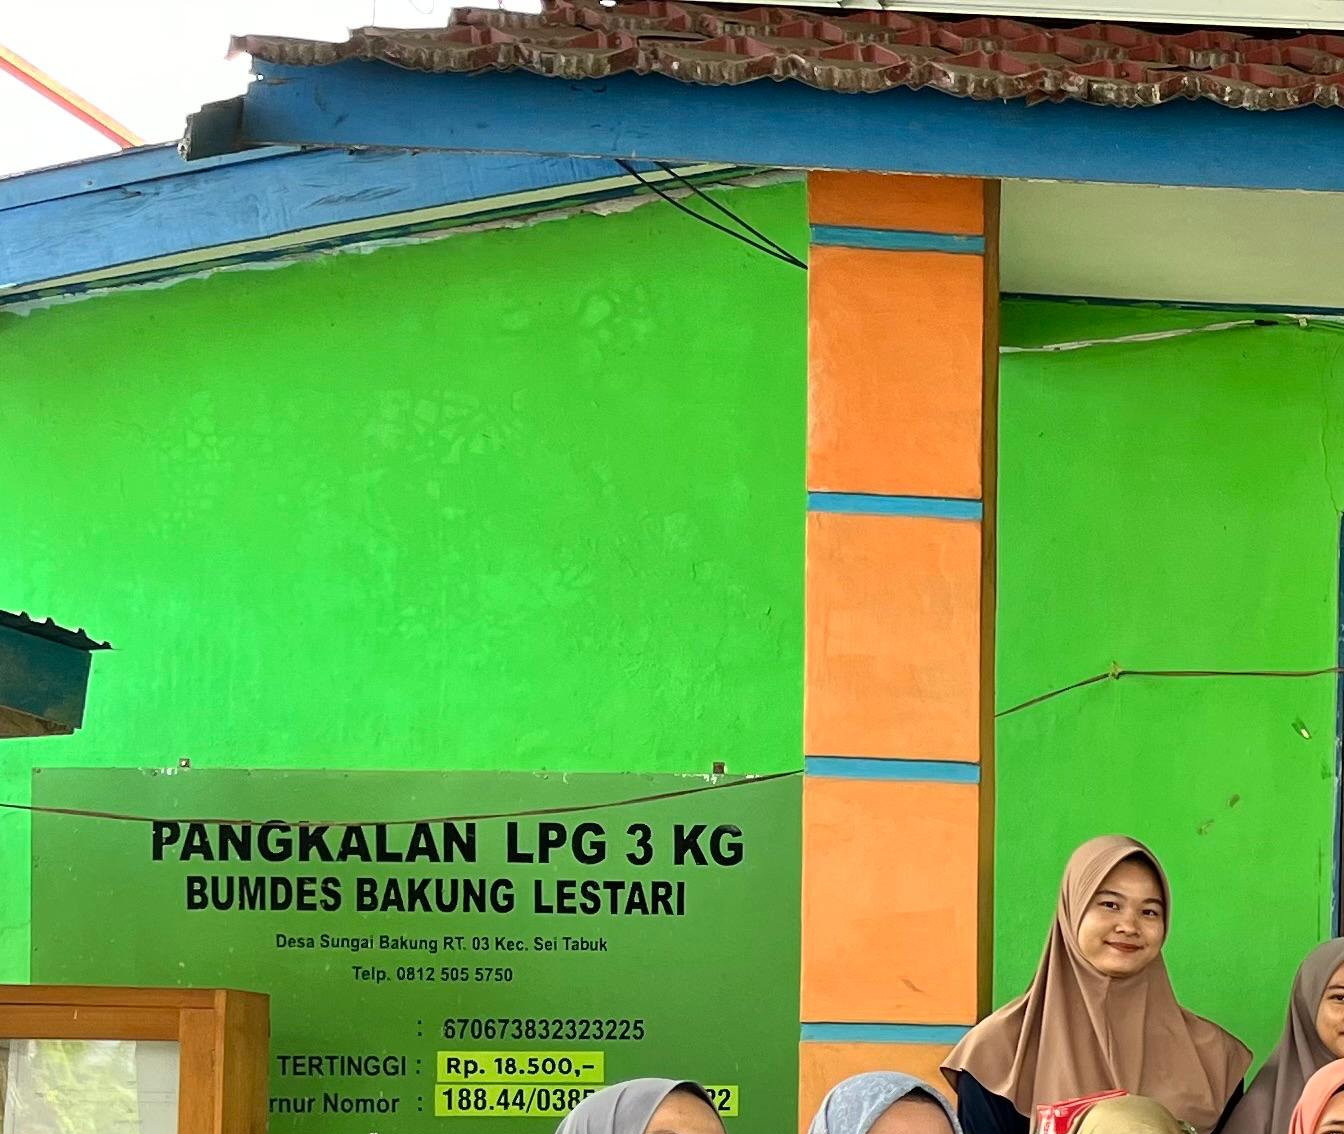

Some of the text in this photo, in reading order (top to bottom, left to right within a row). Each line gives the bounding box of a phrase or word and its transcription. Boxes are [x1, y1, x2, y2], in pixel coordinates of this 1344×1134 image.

[152, 820, 744, 867] PANGKALAN LPG 3 KG
[186, 875, 685, 916] BUMDES BAKUNG LESTARI
[276, 934, 608, 953] Desa Sungai Bakung RT. 03 Kec. Sei Tabuk
[352, 966, 513, 983] Telp. 0812 505 5750
[443, 1018, 645, 1041] 670673832323225
[277, 1056, 406, 1076] TERTINGGI
[446, 1057, 485, 1078] Rp.
[269, 1097, 315, 1113] rnur
[323, 1093, 400, 1113] Nomor
